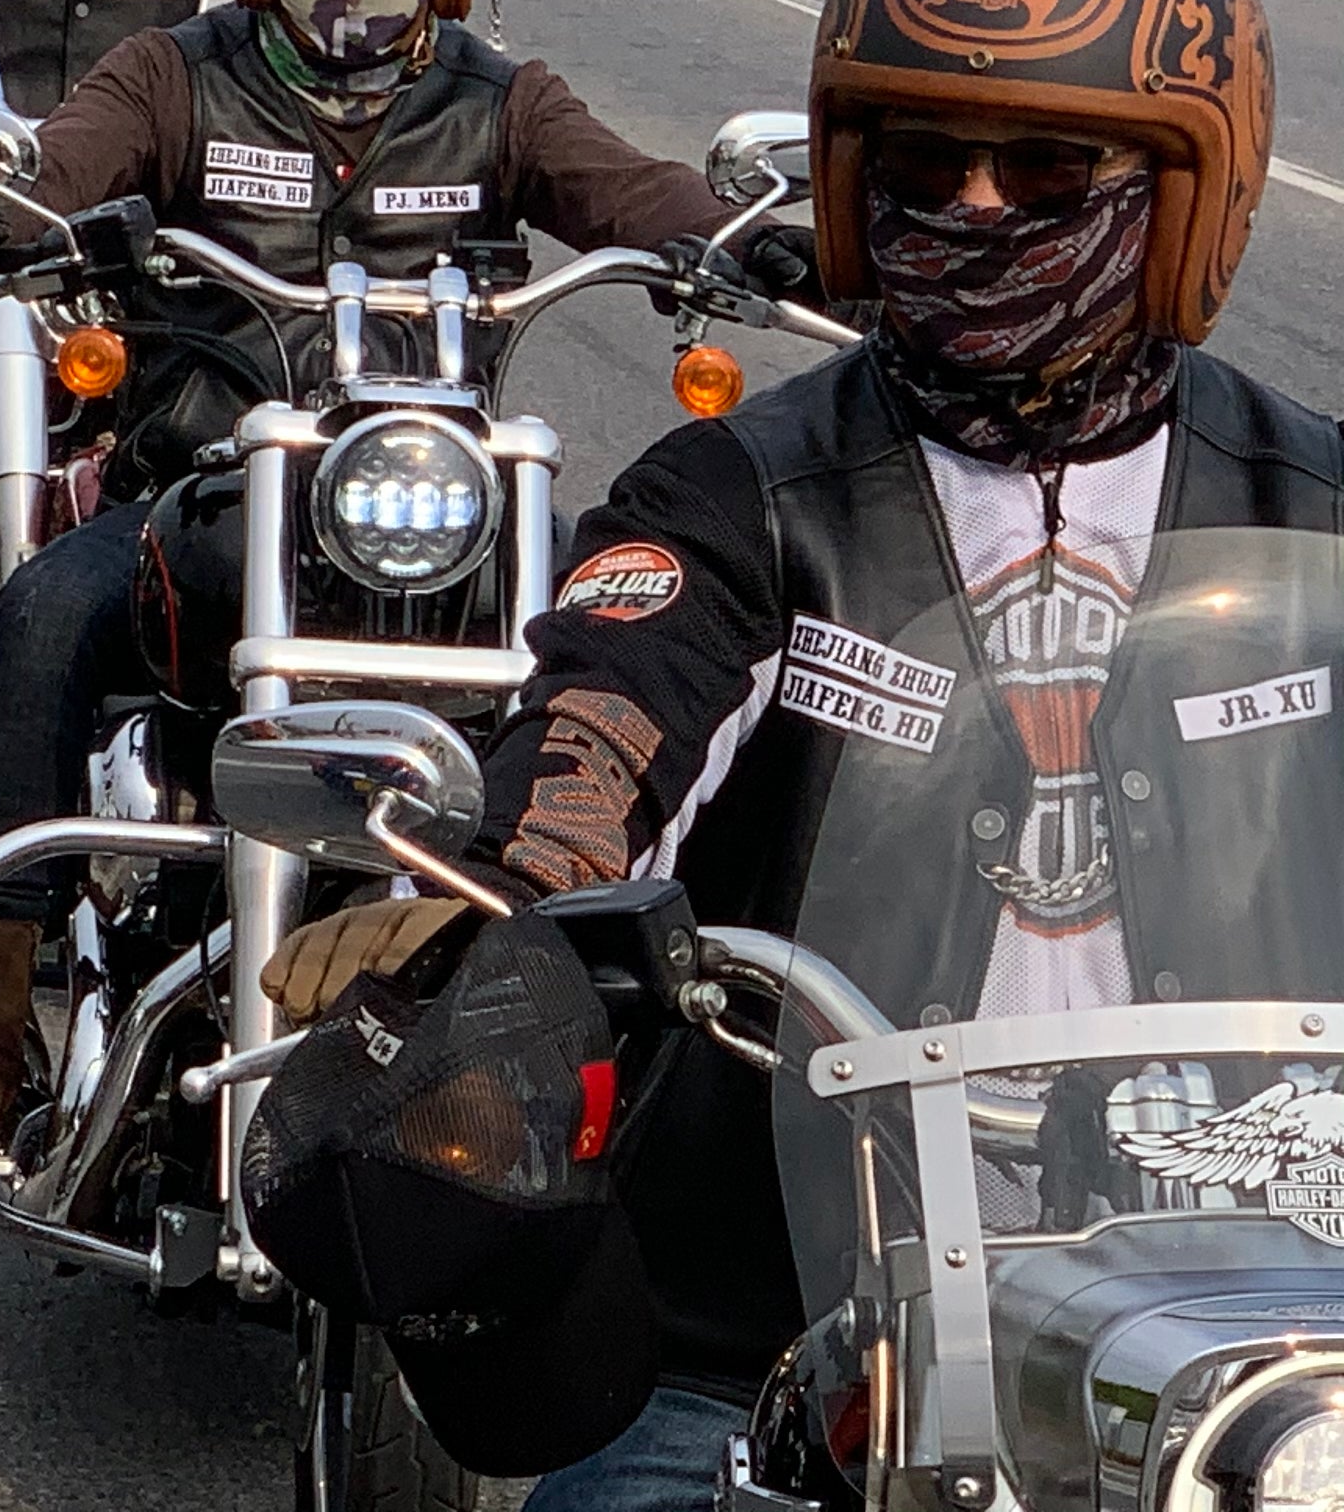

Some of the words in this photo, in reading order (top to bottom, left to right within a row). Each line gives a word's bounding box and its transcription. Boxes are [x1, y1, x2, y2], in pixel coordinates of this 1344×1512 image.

[209, 147, 271, 171] ZHEJIANG
[273, 155, 312, 175] ZHUJI
[285, 186, 310, 204] HD
[385, 191, 413, 209] PJ.
[418, 190, 470, 208] MENG
[791, 624, 887, 680] ZHEJIANG
[888, 660, 954, 701] ZHUJI
[783, 673, 888, 734] JIAFENG.
[892, 711, 935, 744] HD
[1218, 694, 1271, 728] JR.
[1274, 679, 1315, 715] XU
